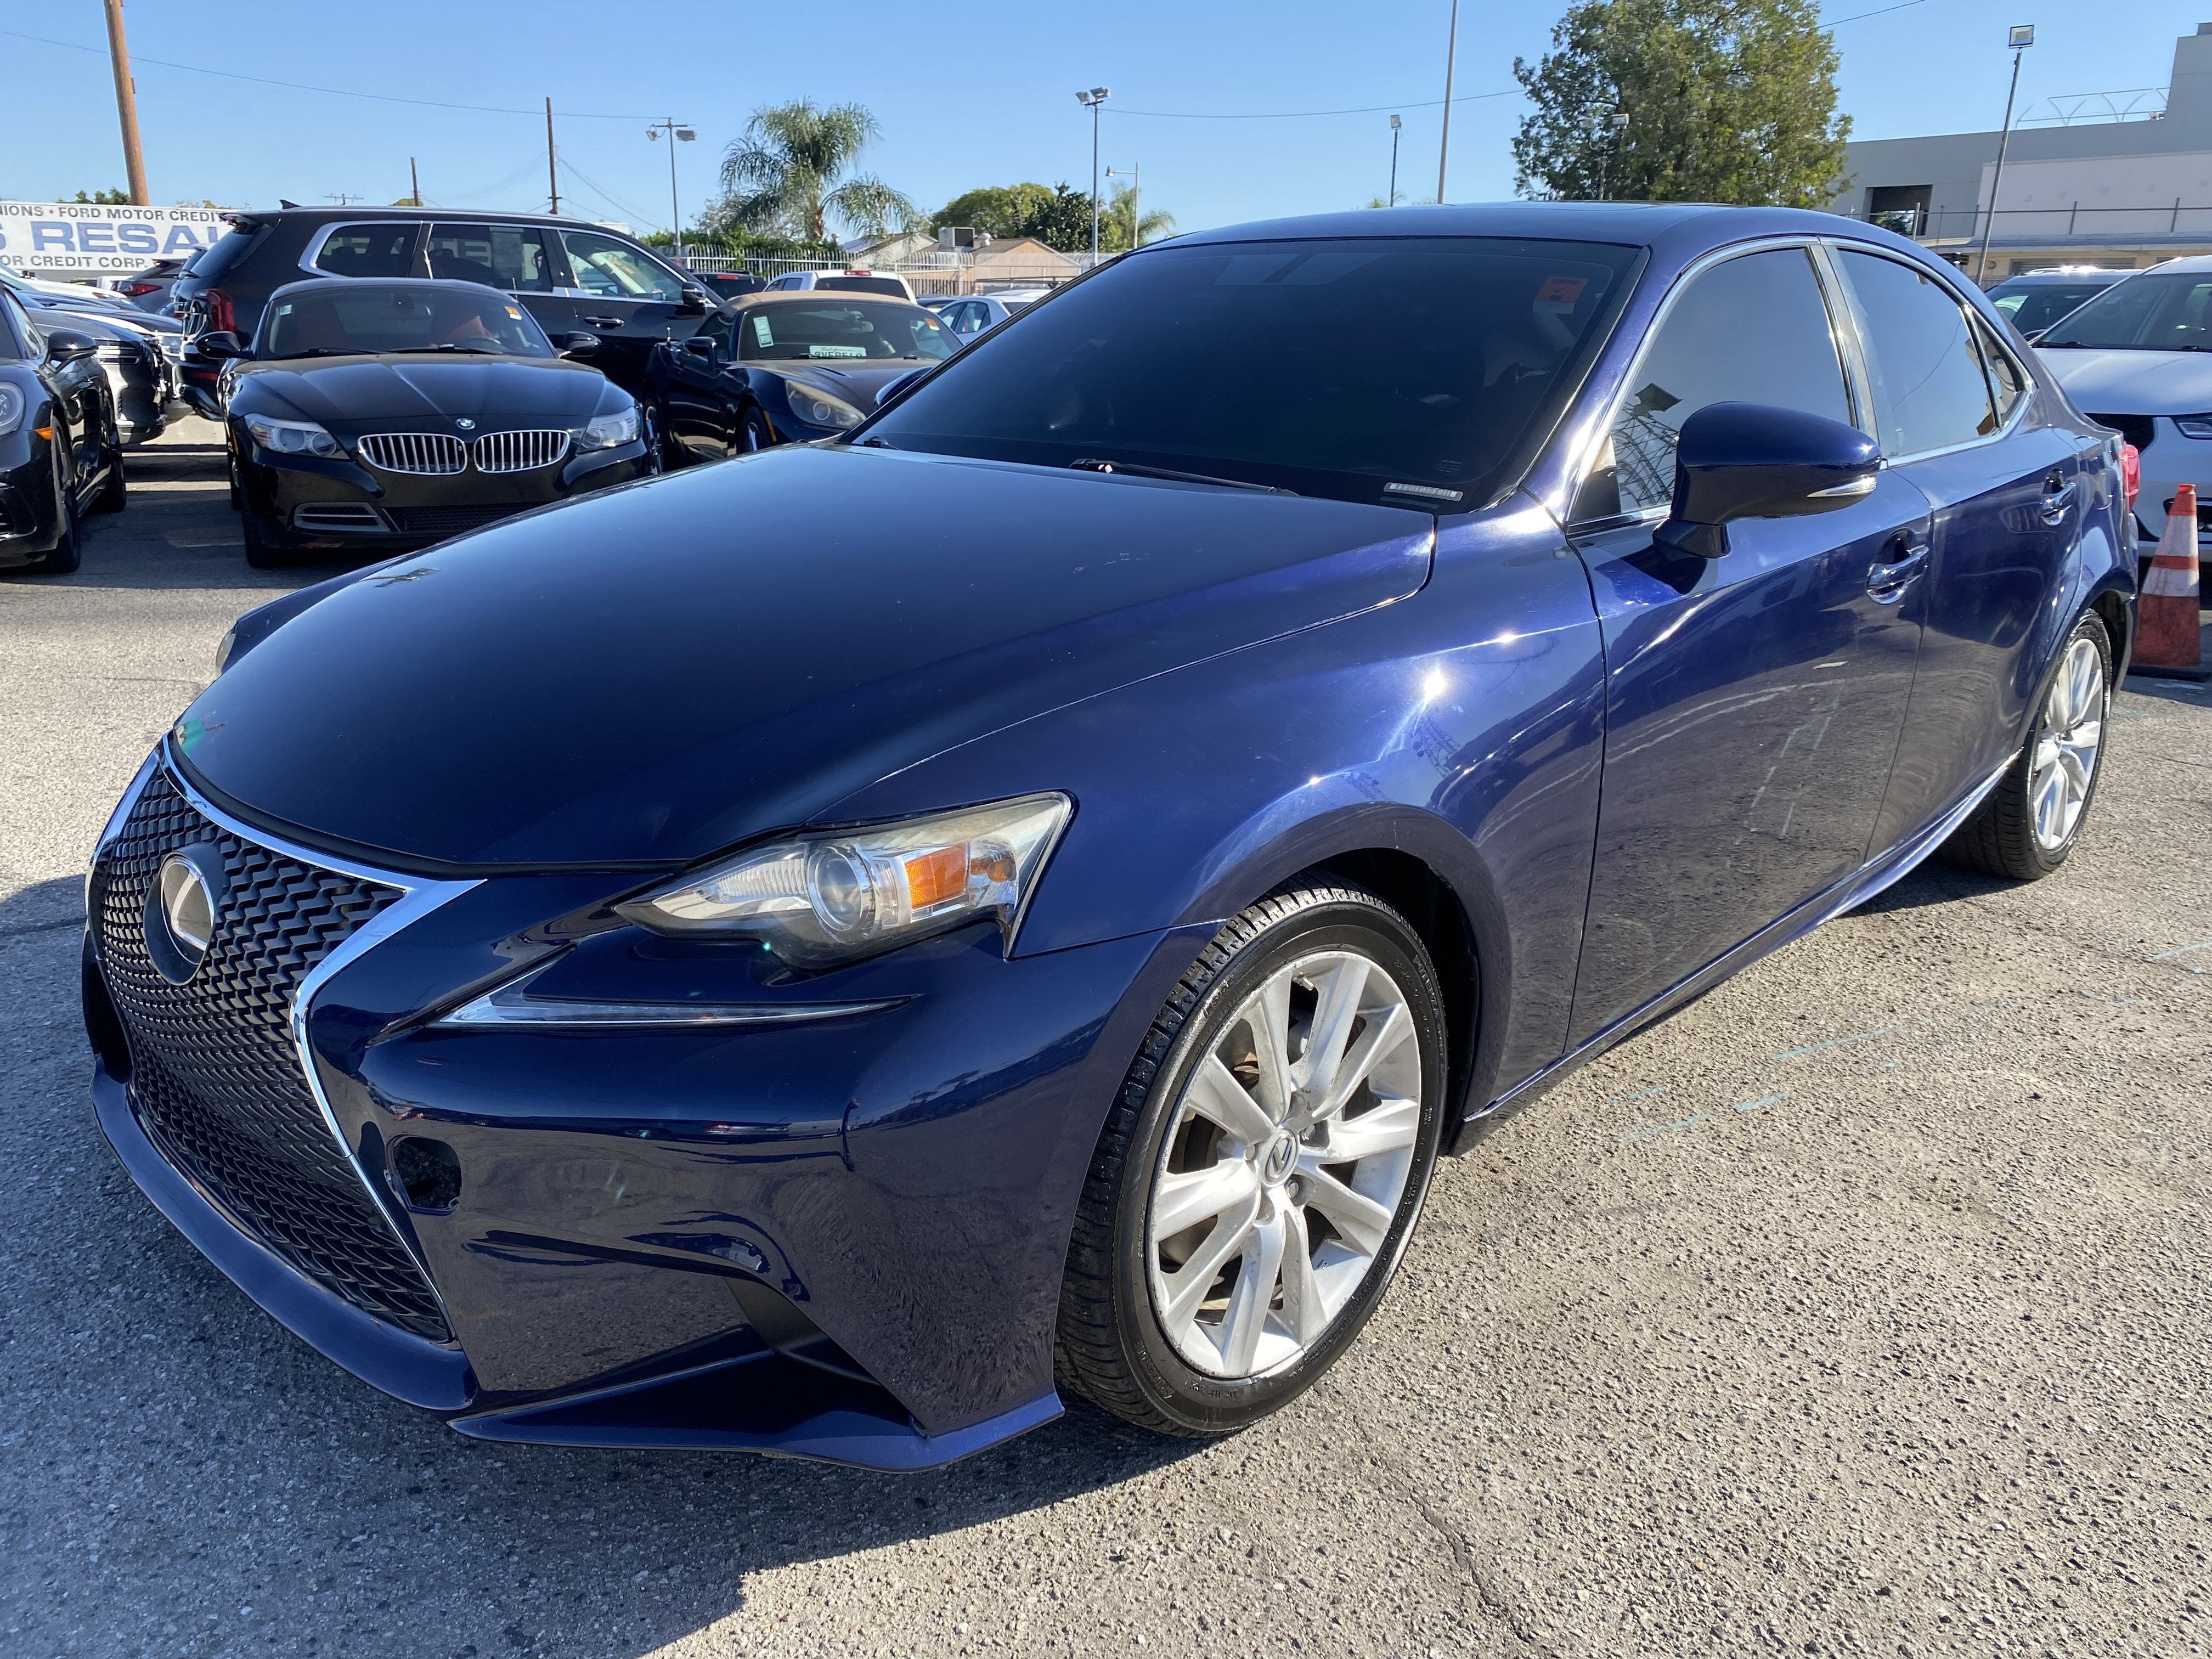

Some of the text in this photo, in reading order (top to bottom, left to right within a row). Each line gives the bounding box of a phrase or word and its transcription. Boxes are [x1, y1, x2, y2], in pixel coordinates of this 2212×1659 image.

[0, 205, 43, 216] IONS
[58, 207, 101, 218] FORD
[106, 209, 164, 220] MOTOR
[31, 256, 92, 267] CREDIT
[99, 257, 148, 268] CORP.
